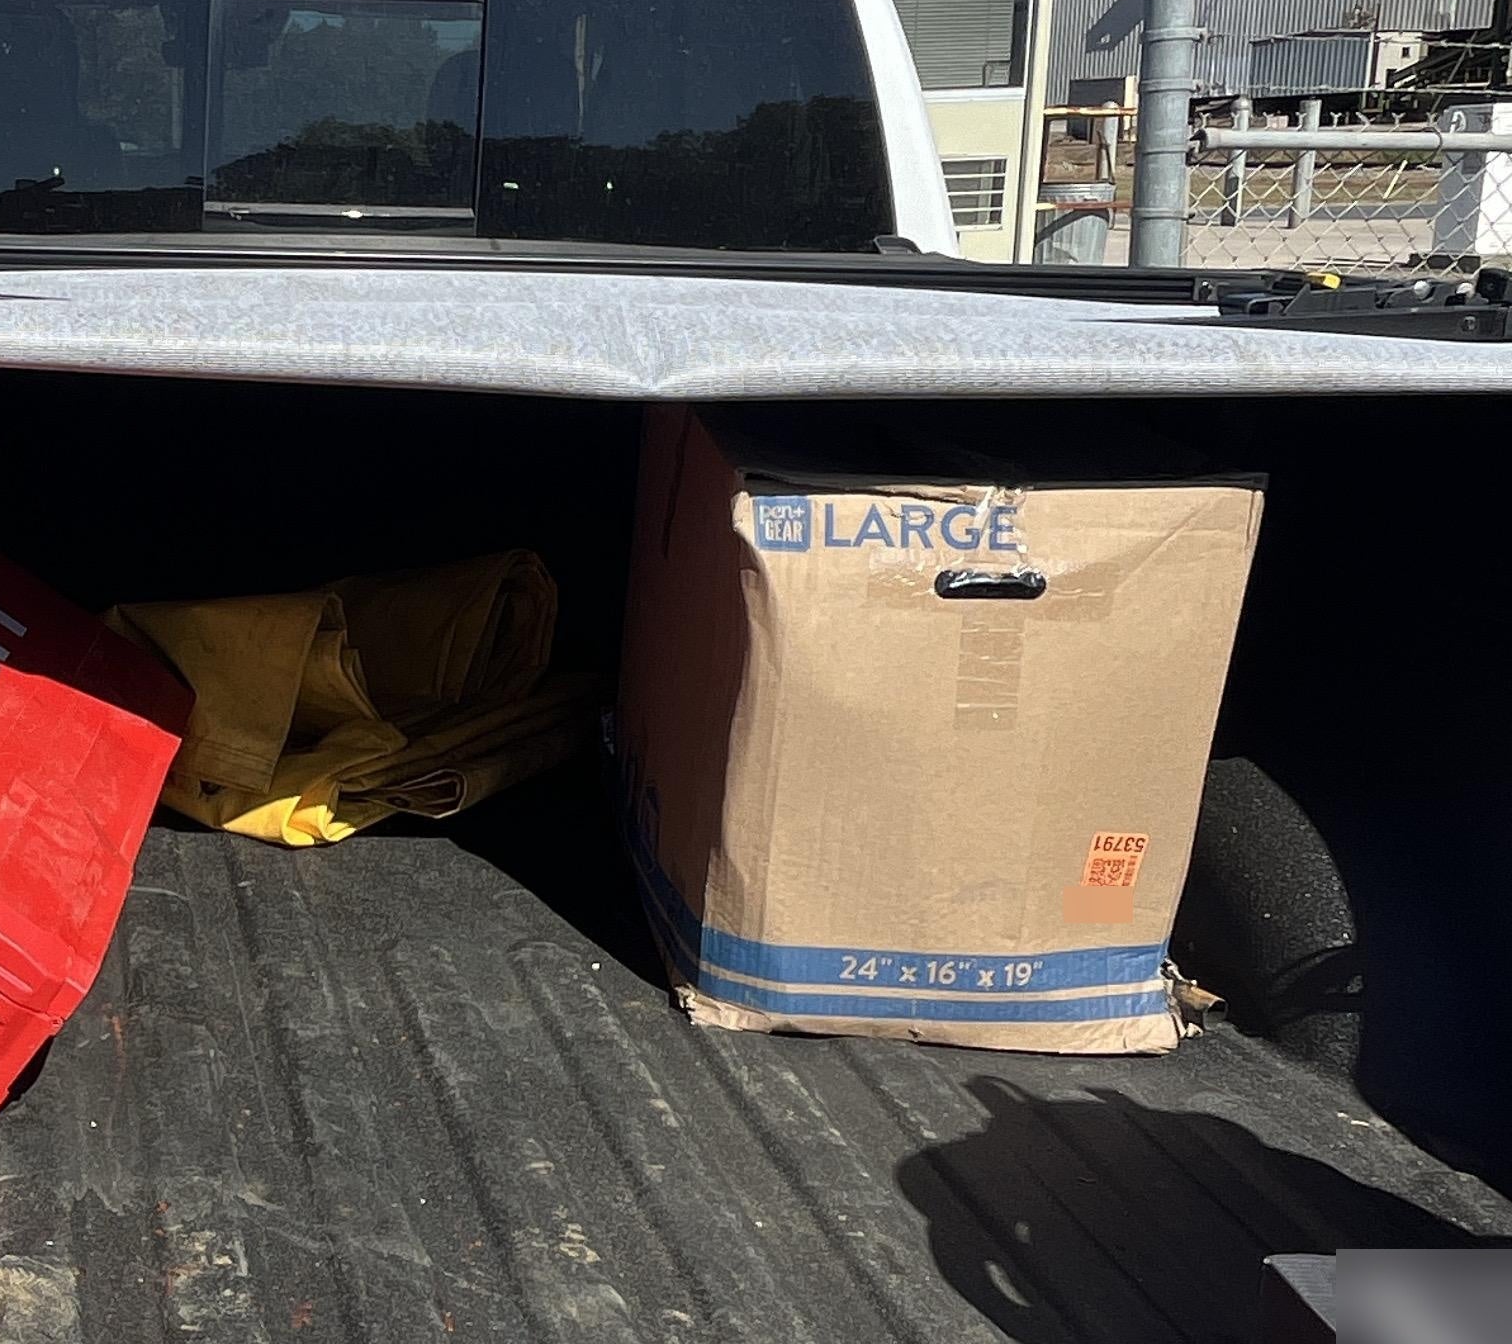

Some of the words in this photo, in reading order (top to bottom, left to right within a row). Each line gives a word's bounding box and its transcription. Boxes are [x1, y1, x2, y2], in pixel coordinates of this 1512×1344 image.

[759, 505, 805, 525] pen+
[823, 503, 1019, 551] LARGE
[765, 519, 803, 543] GEAR
[1093, 835, 1146, 853] 53791
[838, 955, 894, 981] 24"
[898, 965, 919, 984] x
[926, 960, 972, 985] 16"
[976, 968, 996, 988] x
[1004, 960, 1044, 987] 19"
